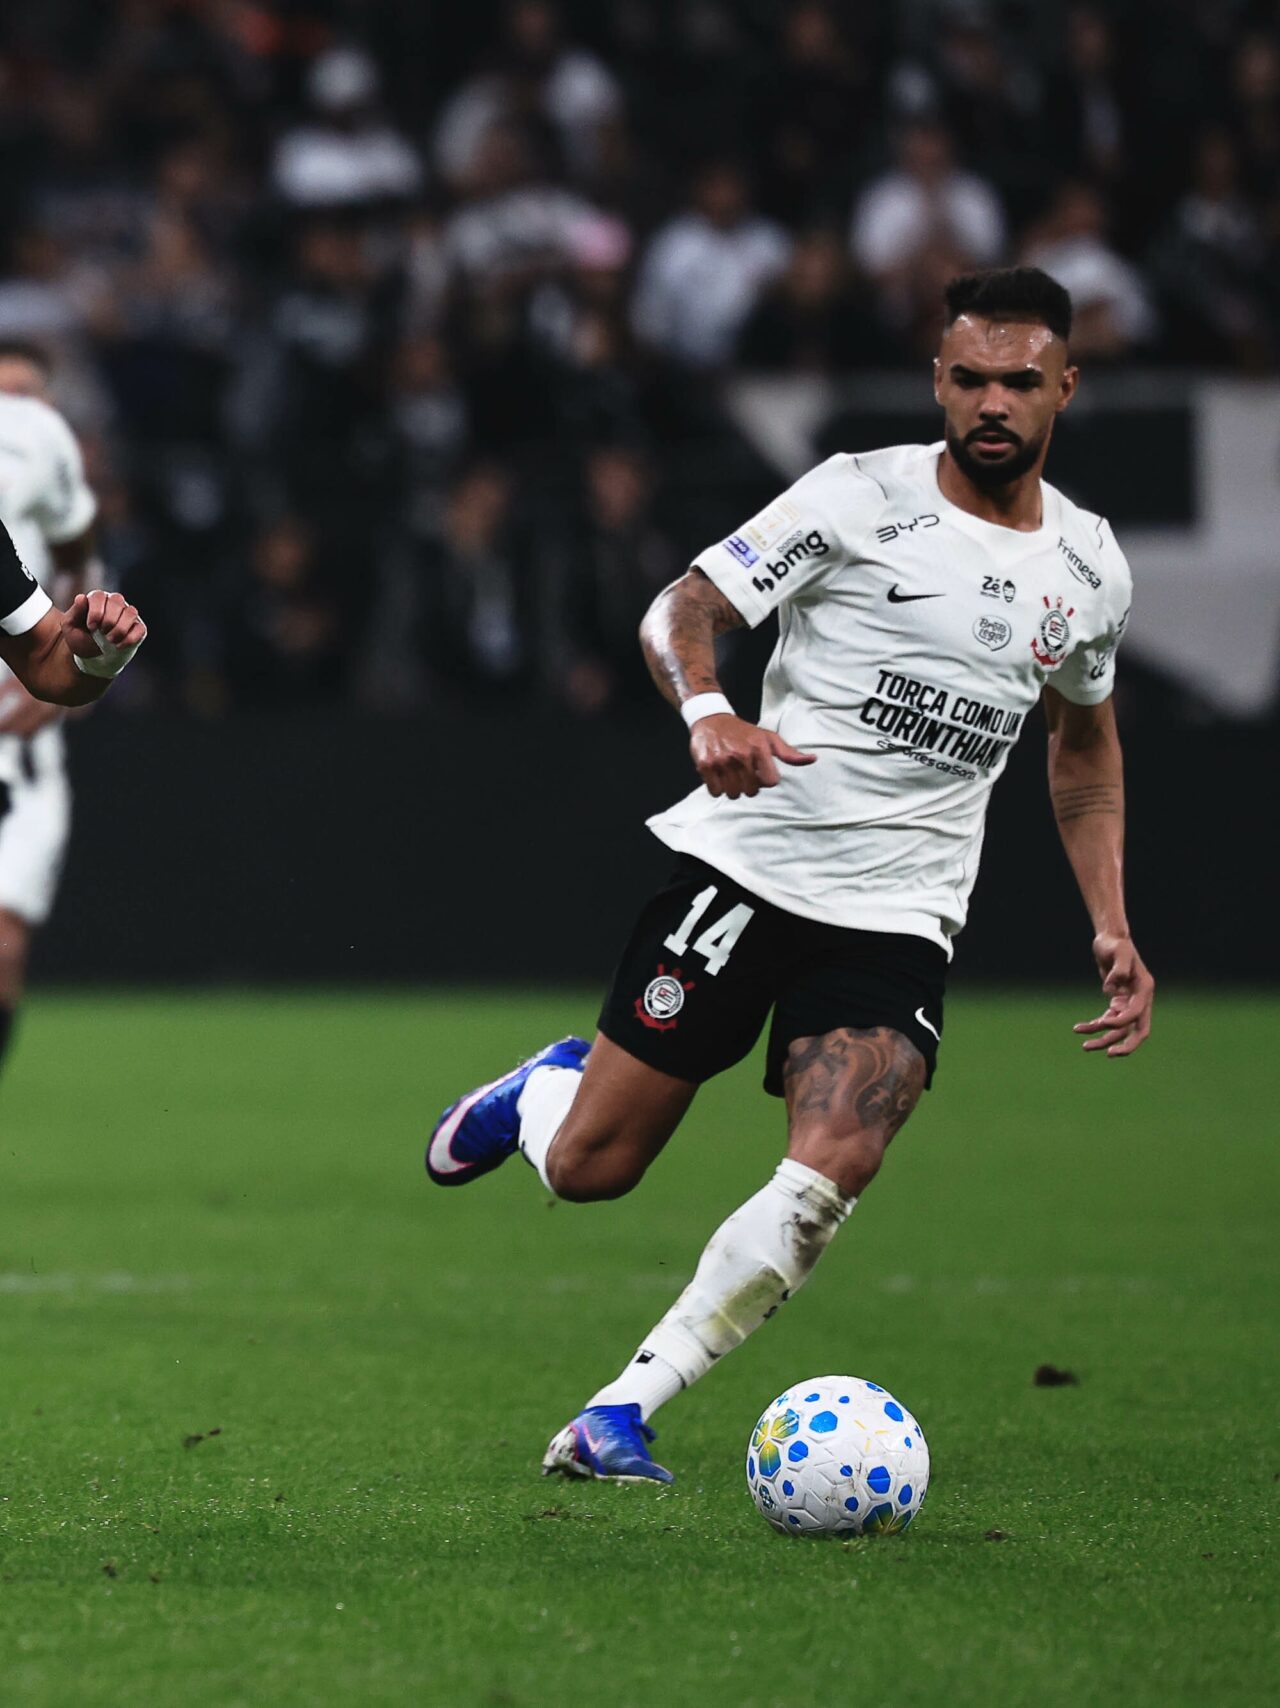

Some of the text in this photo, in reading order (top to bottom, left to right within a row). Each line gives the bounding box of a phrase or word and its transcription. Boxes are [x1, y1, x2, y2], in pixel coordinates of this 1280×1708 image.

[765, 530, 830, 581] bmg
[876, 514, 940, 543] BYD
[1057, 536, 1102, 590] Frimesa
[875, 668, 949, 718] TORÇA
[949, 696, 1005, 735] COMO
[859, 696, 1012, 769] CORINTHIAN
[663, 884, 755, 977] 14
